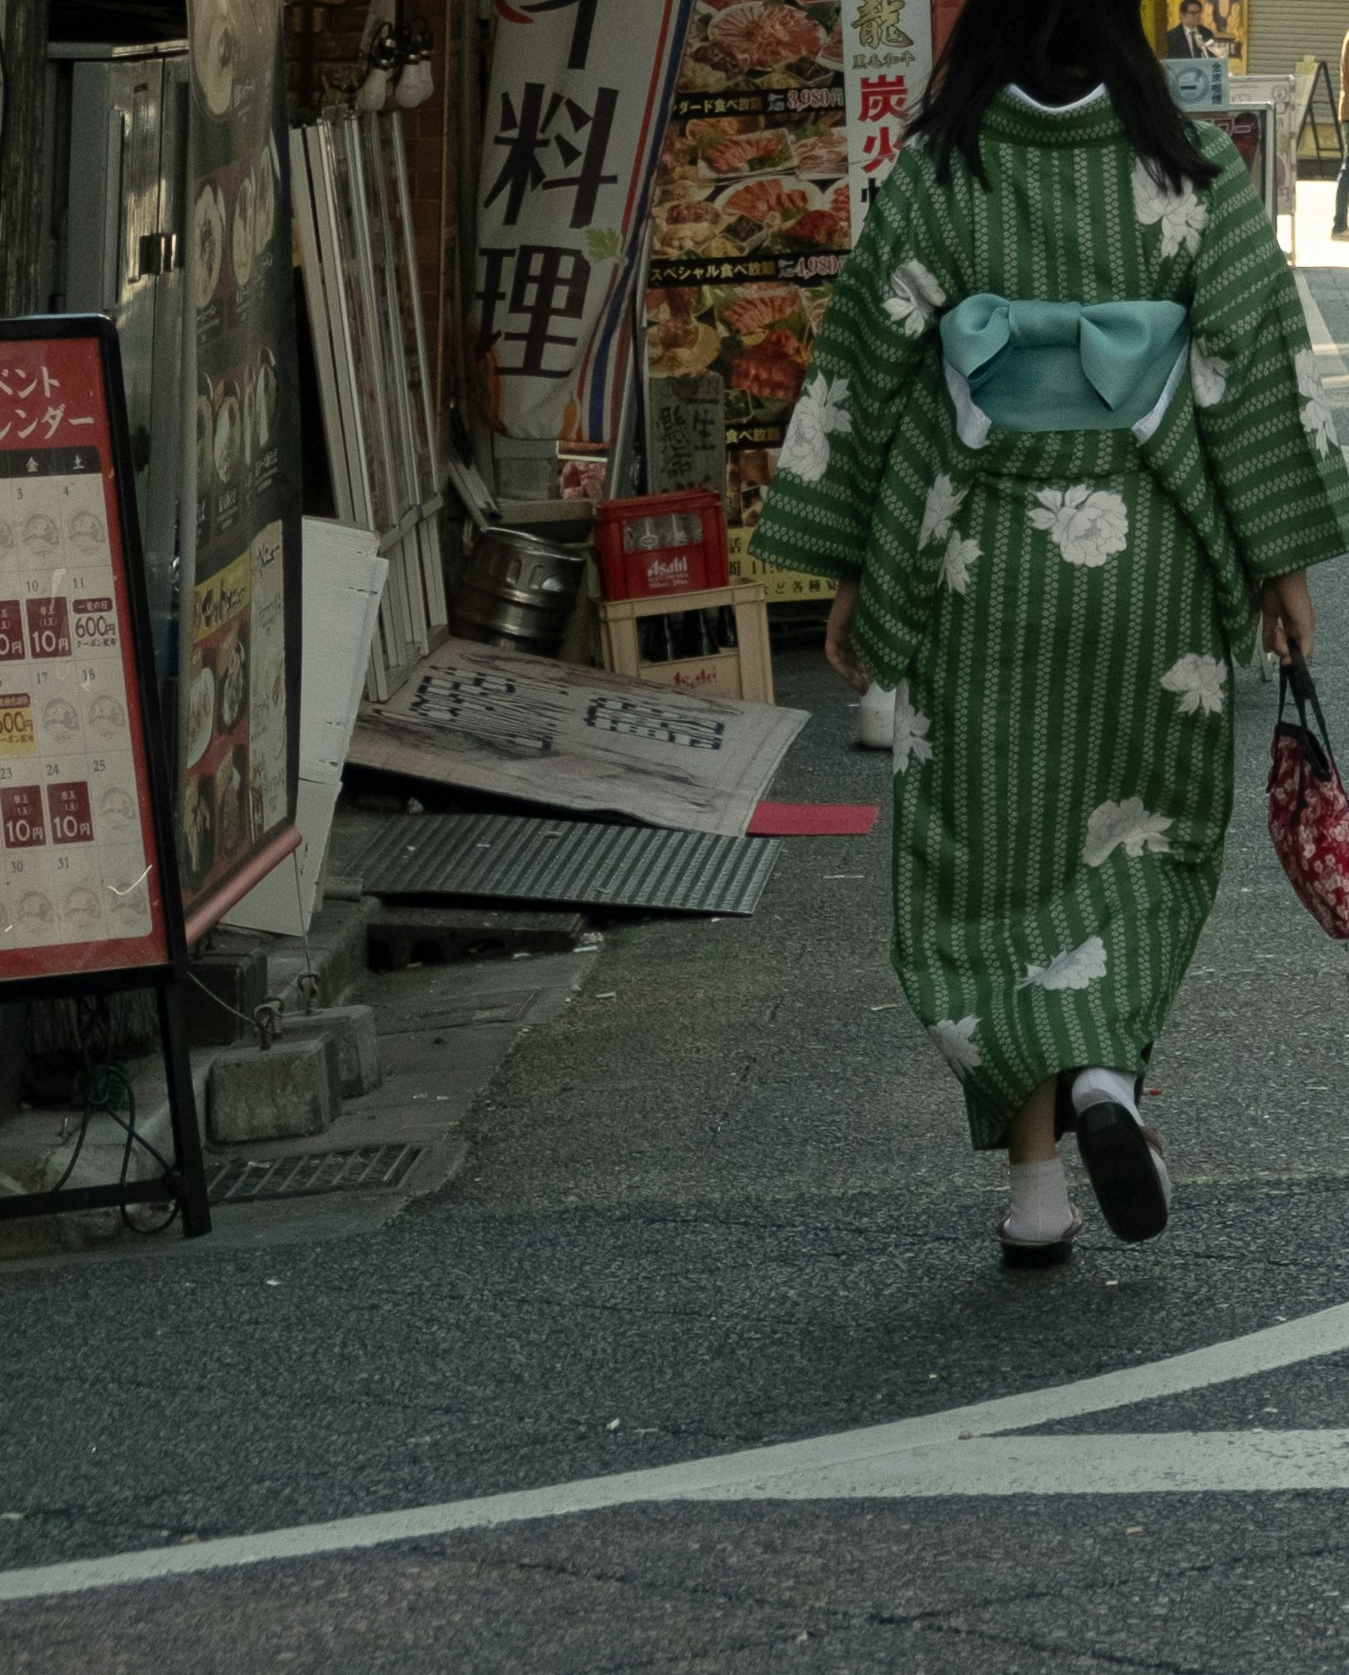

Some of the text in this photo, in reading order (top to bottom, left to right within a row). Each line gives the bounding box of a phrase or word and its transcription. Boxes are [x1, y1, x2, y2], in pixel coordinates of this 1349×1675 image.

[73, 577, 86, 590] 11
[31, 615, 116, 654] 10円 600円
[6, 815, 91, 843] 10円 10円
